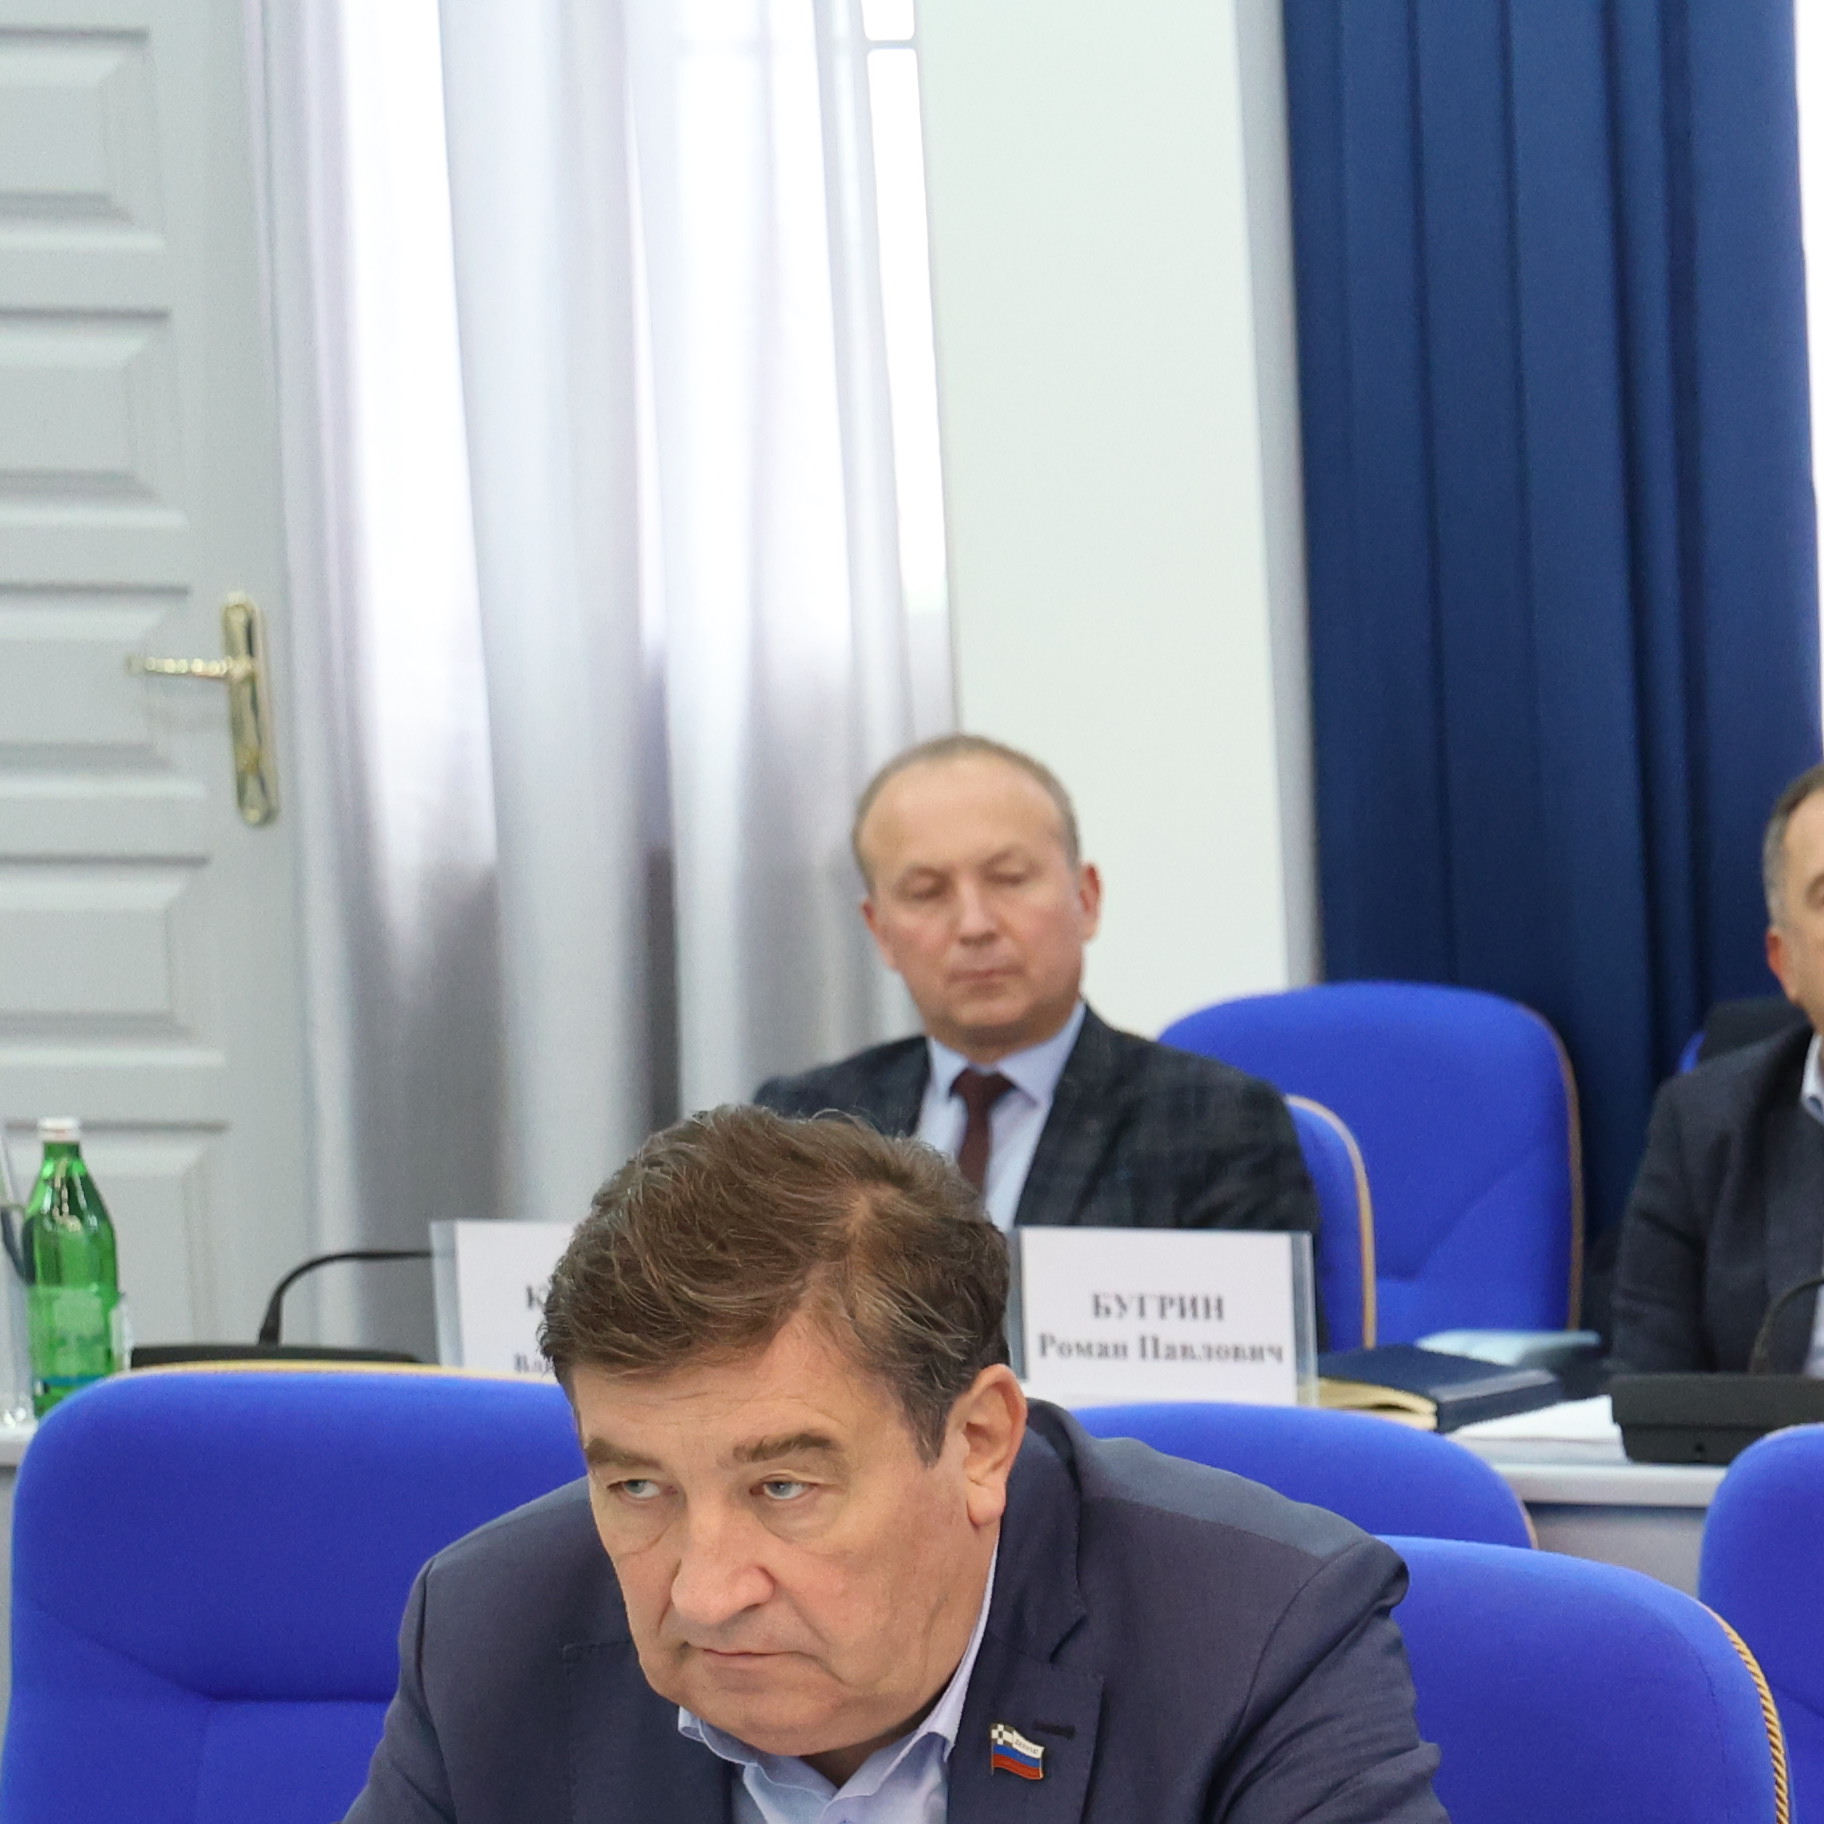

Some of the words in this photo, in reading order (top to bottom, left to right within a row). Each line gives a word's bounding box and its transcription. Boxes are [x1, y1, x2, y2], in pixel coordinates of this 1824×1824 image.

[1091, 1292, 1226, 1322] БУГРИН
[1037, 1332, 1130, 1361] Роман
[1138, 1334, 1284, 1364] Павлович
